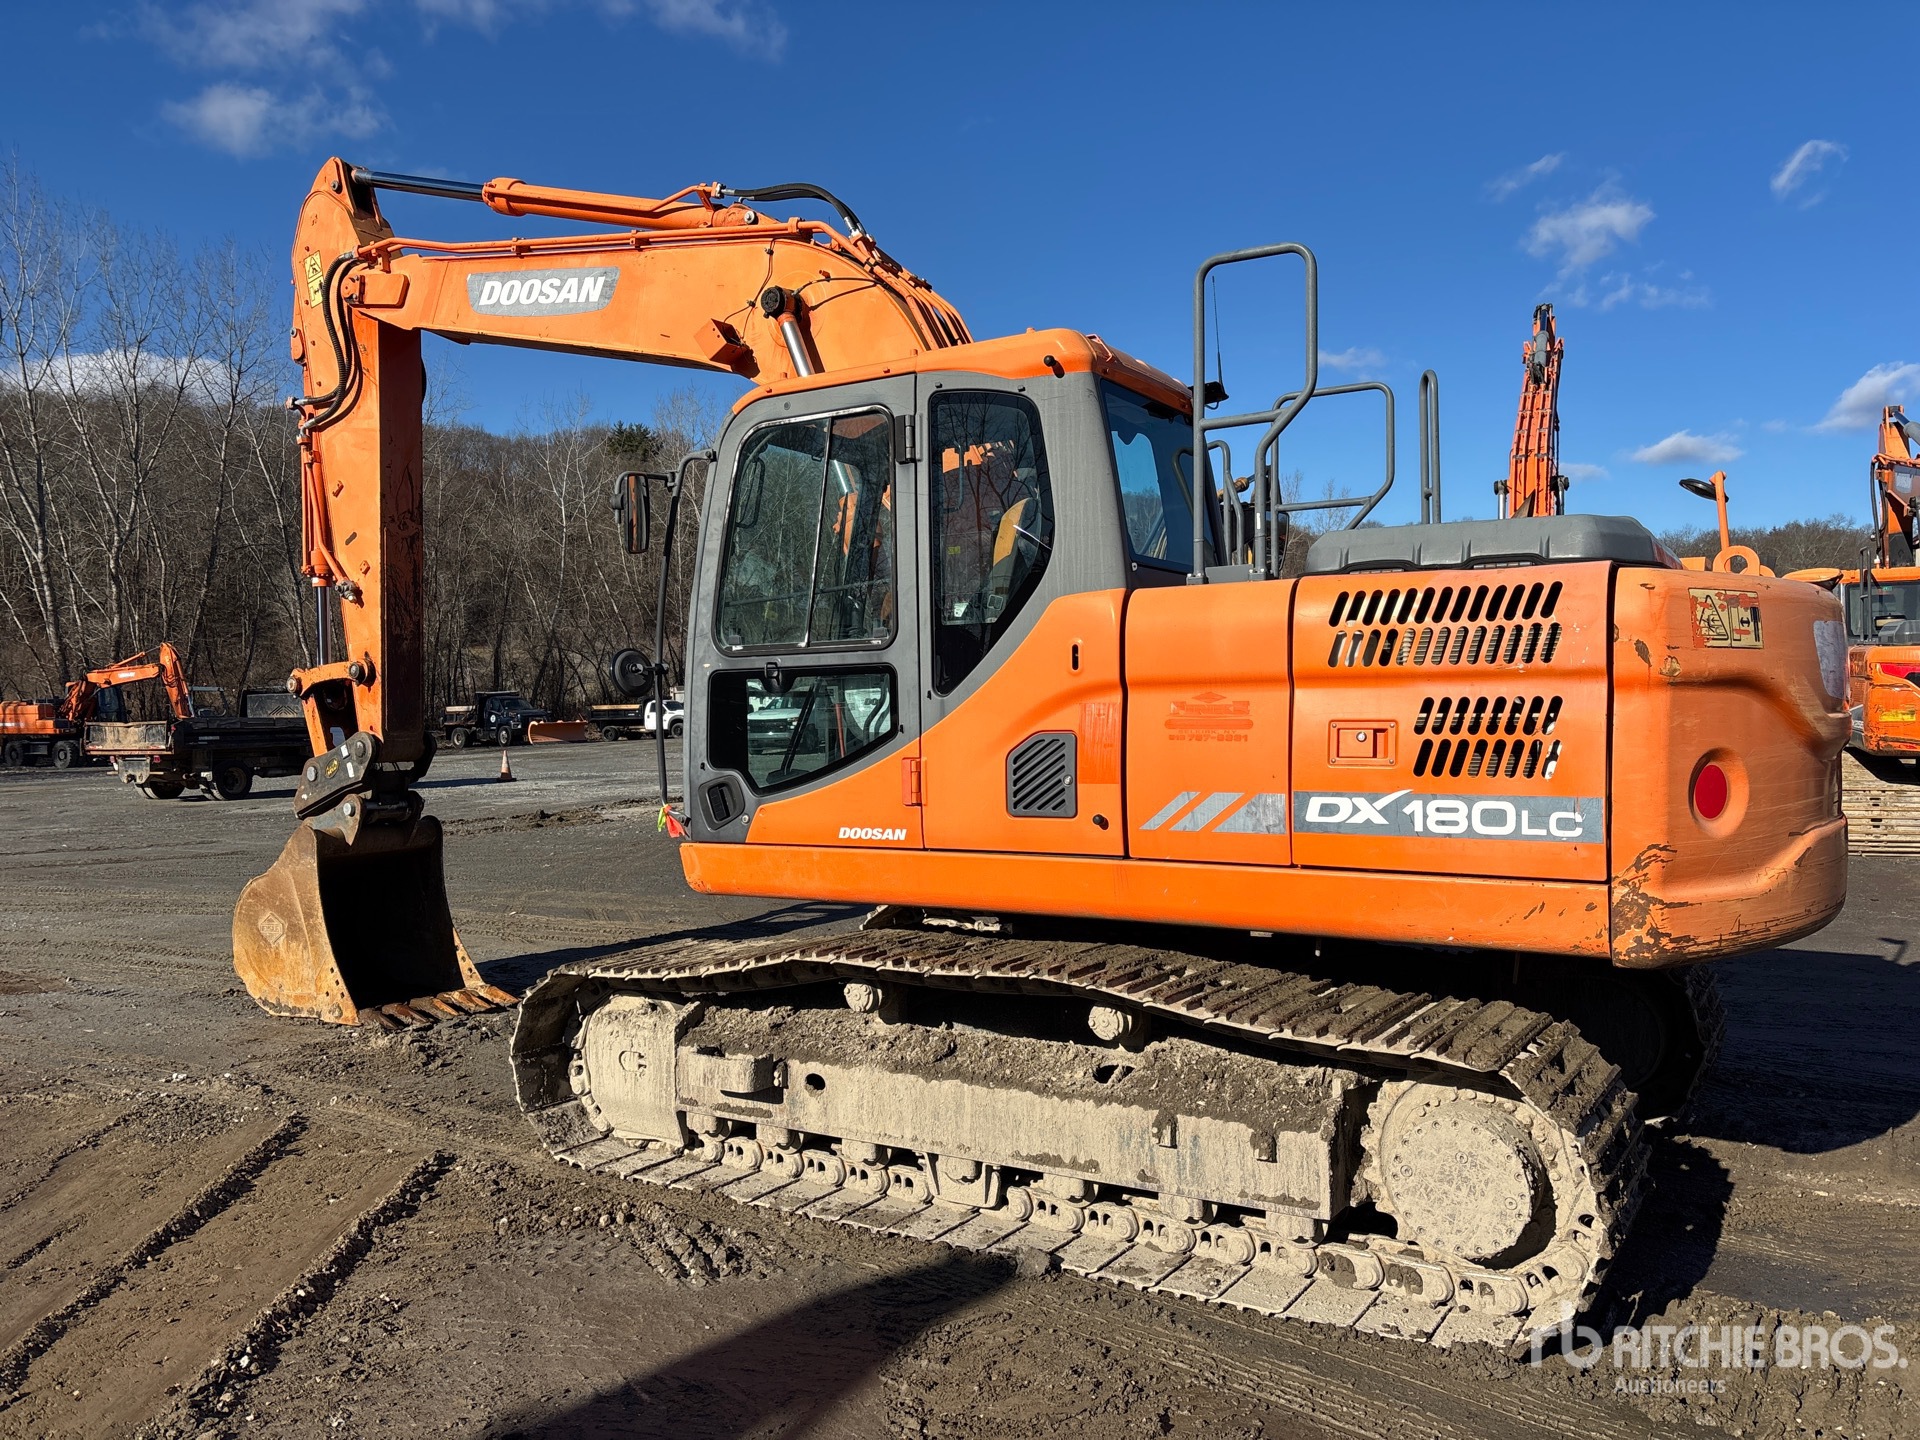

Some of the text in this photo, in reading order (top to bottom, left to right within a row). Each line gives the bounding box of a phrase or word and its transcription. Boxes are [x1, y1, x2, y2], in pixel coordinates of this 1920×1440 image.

[479, 276, 606, 306] DOOSAN
[1305, 789, 1414, 825] DX
[838, 827, 907, 841] DOOSAN
